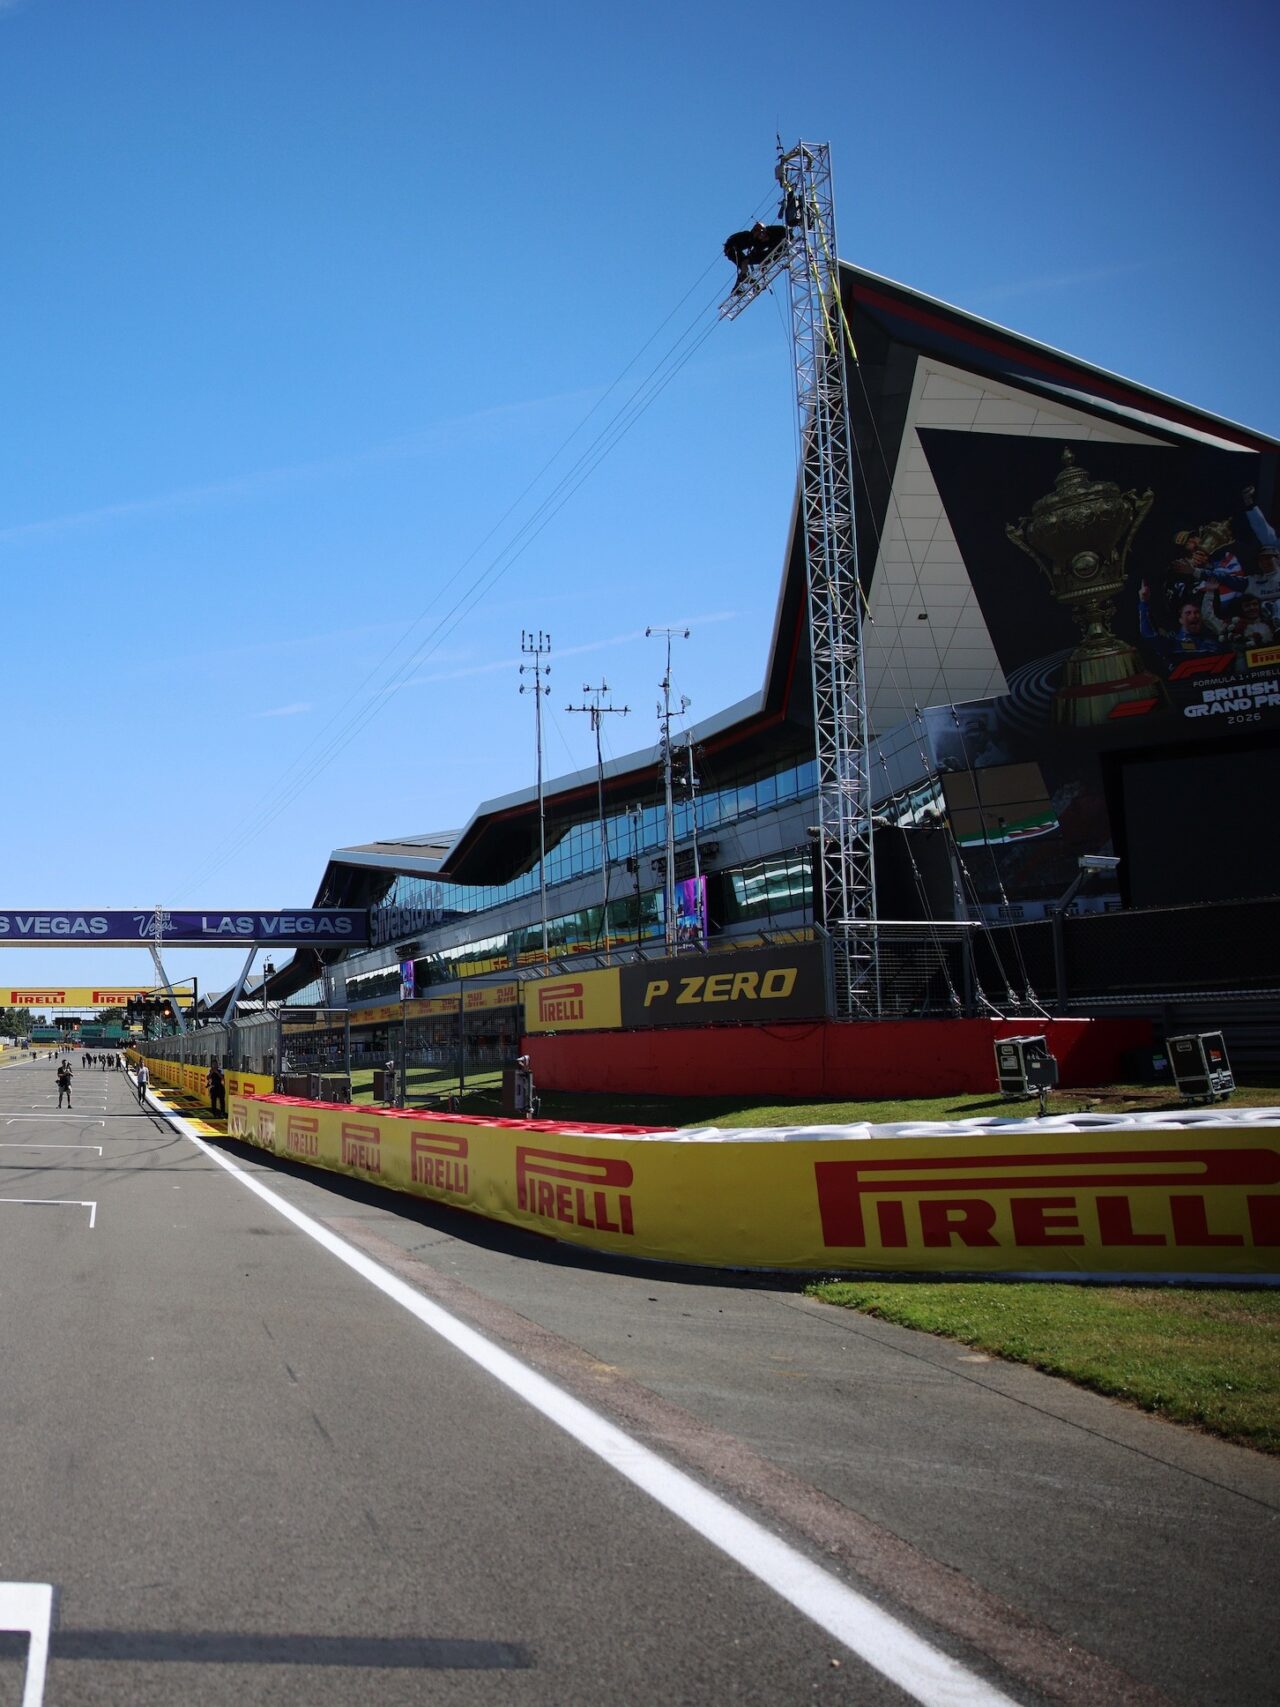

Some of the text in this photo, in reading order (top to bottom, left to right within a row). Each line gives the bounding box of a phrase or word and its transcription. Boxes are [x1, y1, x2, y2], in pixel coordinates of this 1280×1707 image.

[1193, 675, 1236, 687] FORMULA
[1251, 668, 1280, 678] PIRELL
[1202, 680, 1279, 703] BRITISH
[1183, 693, 1280, 718] GRAND PR
[1227, 712, 1262, 724] 2026
[16, 916, 108, 934] VEGAS
[202, 916, 255, 934] LAS
[259, 916, 353, 934] VEGAS
[11, 991, 66, 1003] PIRELLI
[538, 982, 584, 1023] PIRELLI
[643, 967, 798, 1007] P ZERO
[287, 1114, 319, 1157] PIRELLI
[341, 1121, 381, 1175] PIRELLI
[411, 1131, 469, 1195] PIRELLI
[516, 1145, 635, 1236] PIRELLI
[814, 1148, 1280, 1247] PIRELLI
